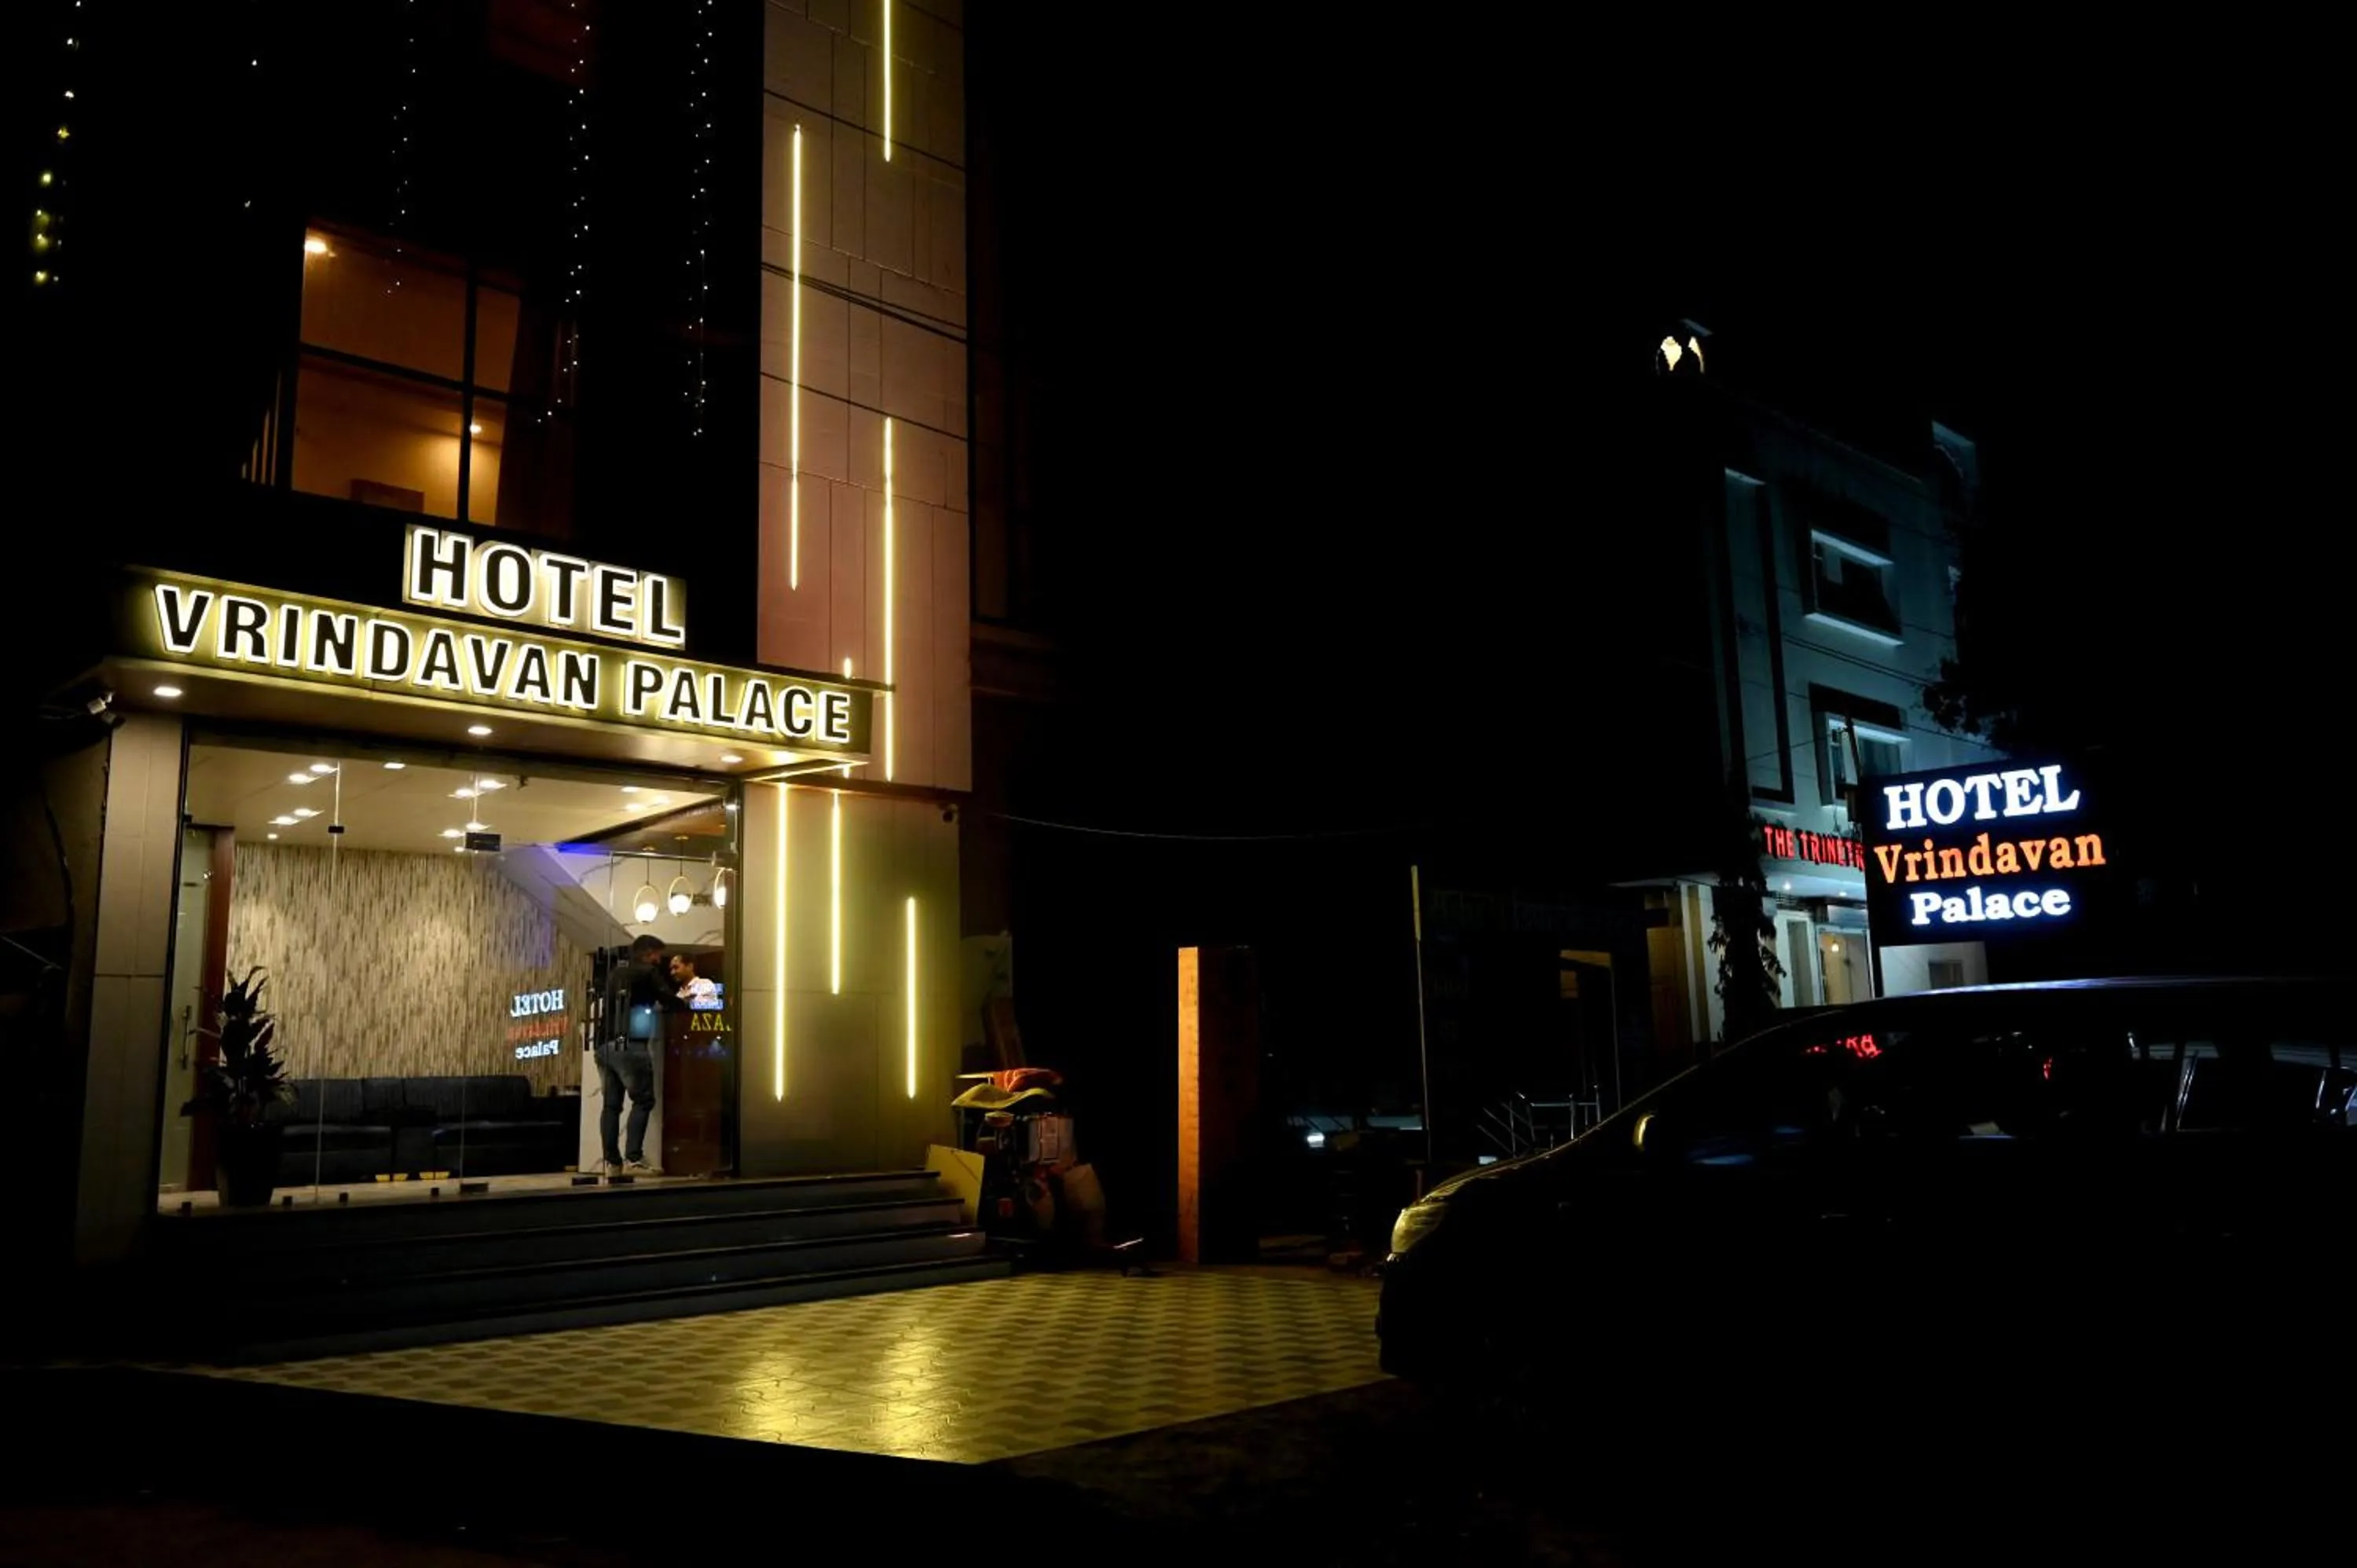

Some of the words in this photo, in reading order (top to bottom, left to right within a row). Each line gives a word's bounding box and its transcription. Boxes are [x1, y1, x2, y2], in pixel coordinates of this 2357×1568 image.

[409, 526, 685, 647] HOTEL
[154, 584, 600, 712] VRINDAVAN
[623, 660, 852, 744] PALACE
[1883, 764, 2081, 830] HOTEL
[1764, 825, 1795, 858] THE
[1873, 832, 2106, 885] Vrindavan
[1910, 886, 2072, 925] Palace
